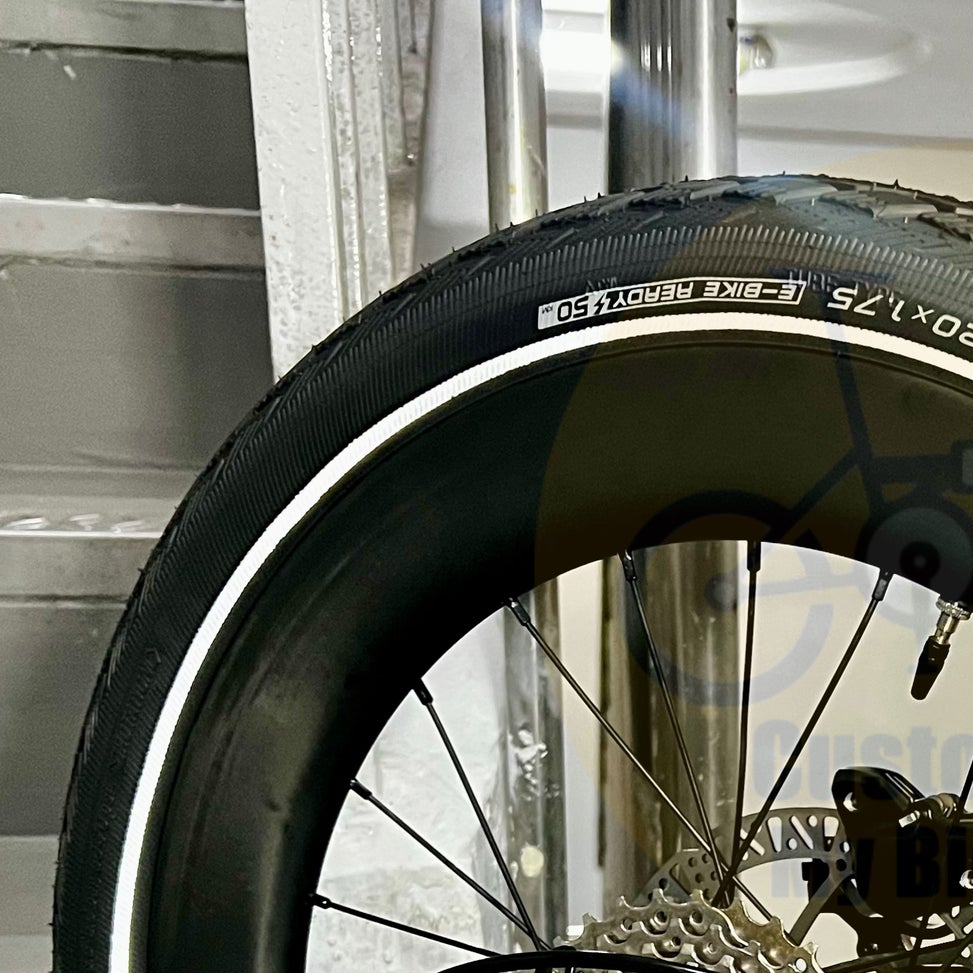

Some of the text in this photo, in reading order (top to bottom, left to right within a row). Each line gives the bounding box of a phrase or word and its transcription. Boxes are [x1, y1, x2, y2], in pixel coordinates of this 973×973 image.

[611, 281, 694, 308] READY
[703, 280, 793, 300] E-BIKE
[557, 295, 589, 322] 50
